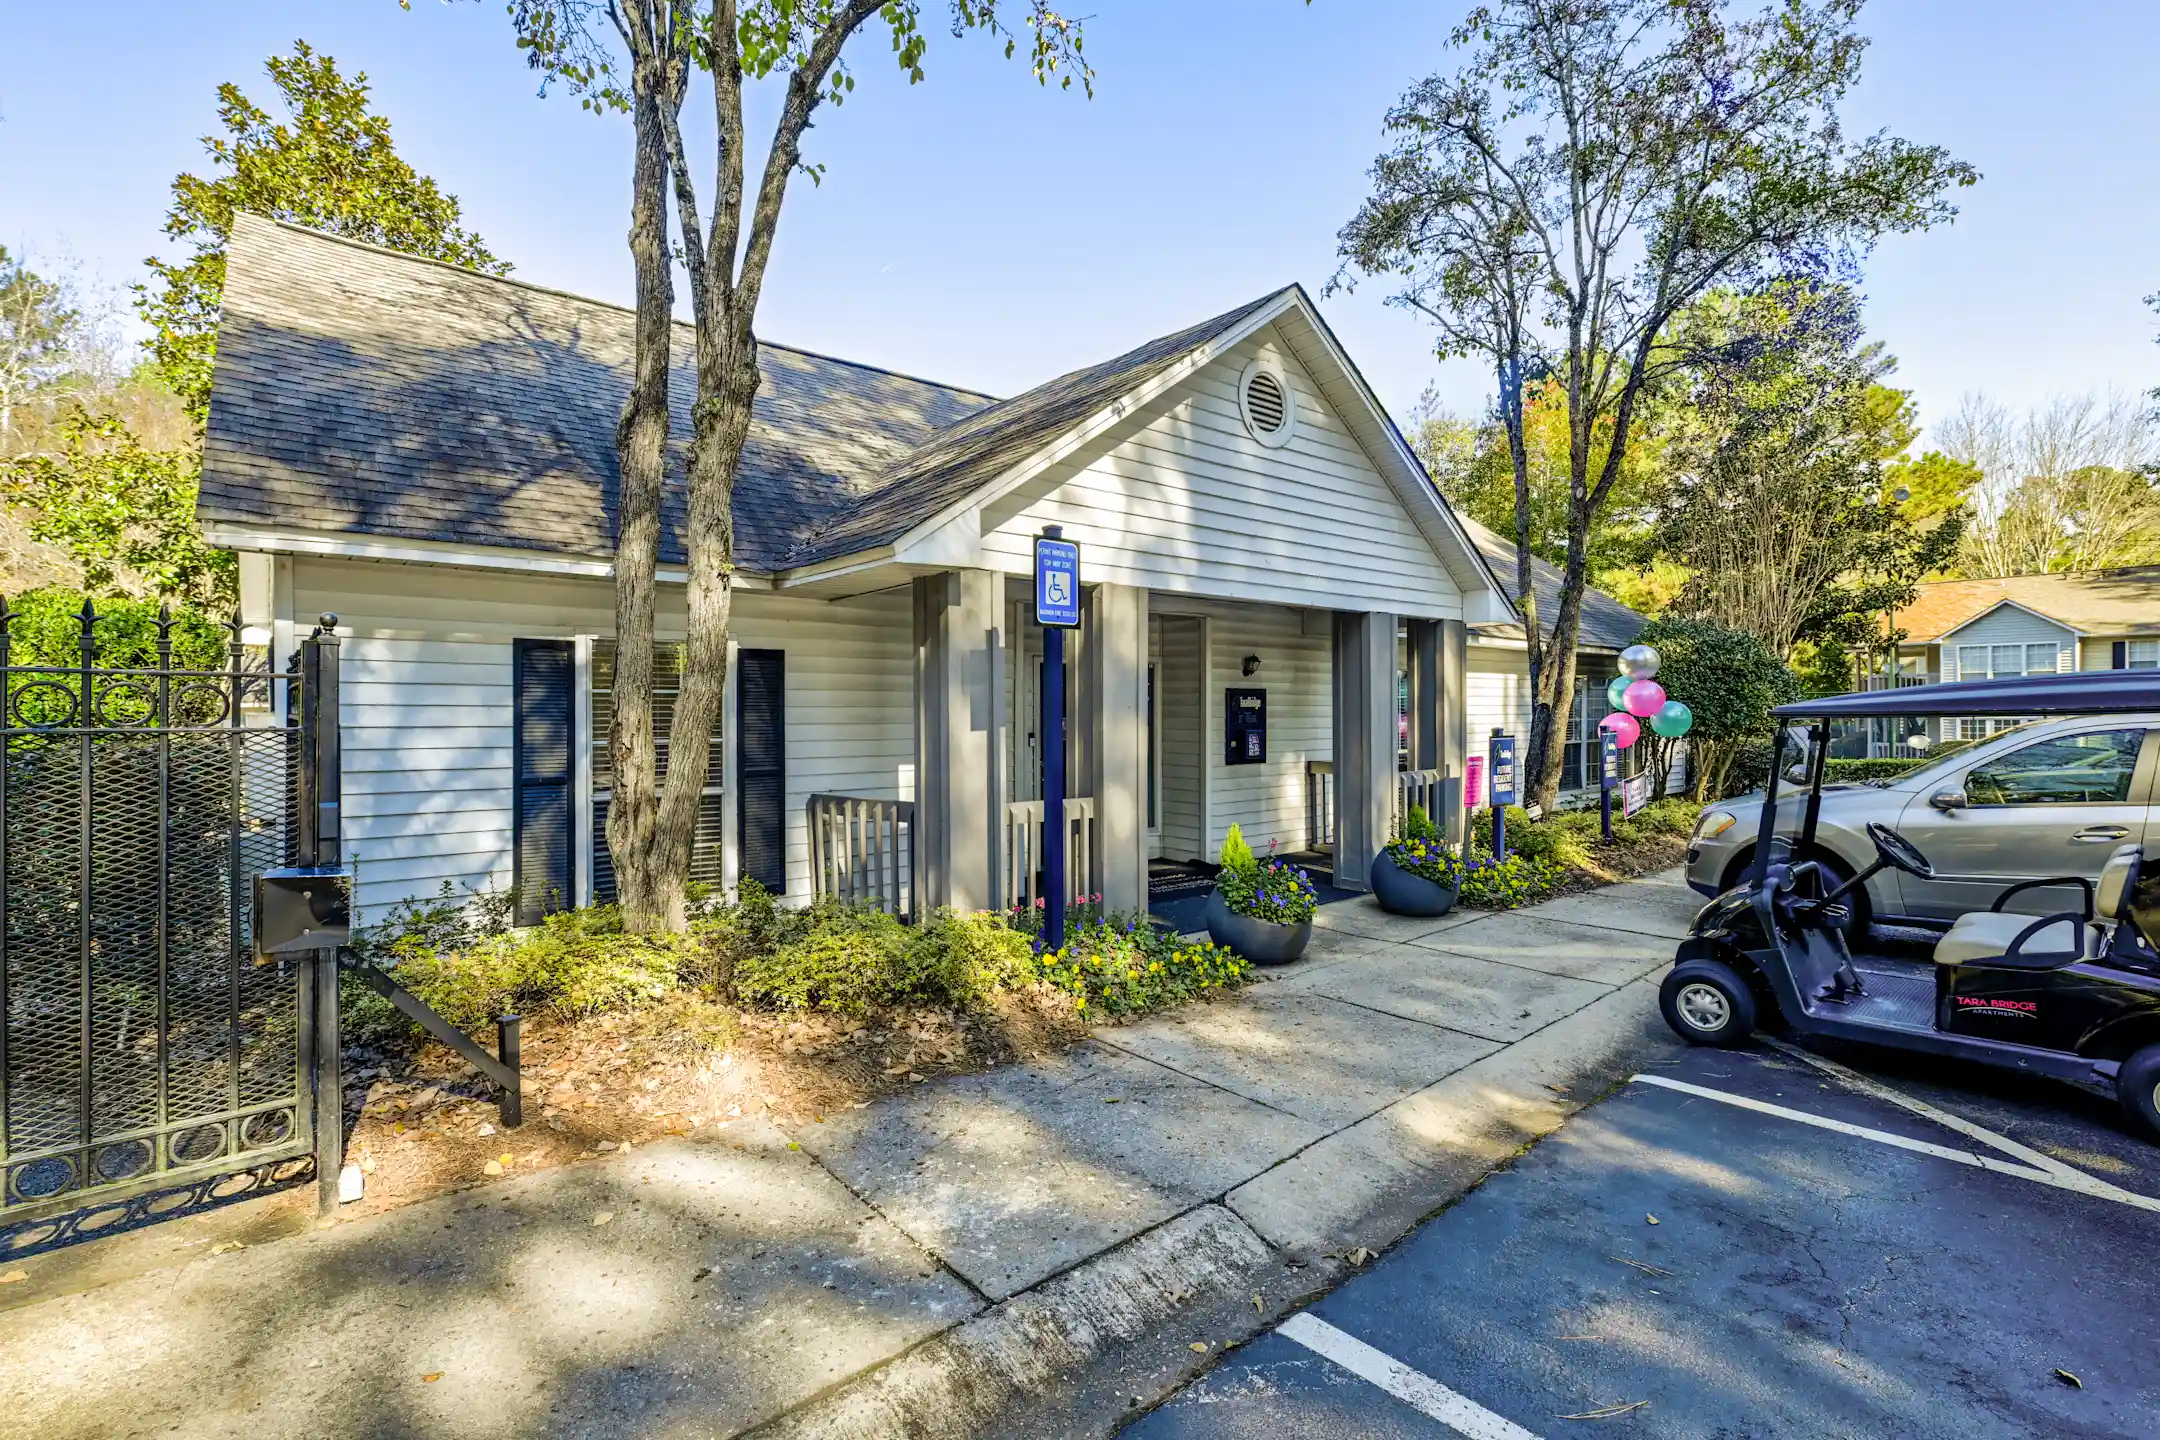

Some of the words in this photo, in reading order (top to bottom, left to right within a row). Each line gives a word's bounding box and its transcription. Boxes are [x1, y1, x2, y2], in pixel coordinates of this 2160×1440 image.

[1956, 996, 1989, 1007] TARA
[1990, 999, 2037, 1012] BRIDGE
[1972, 1009, 2025, 1018] APARTMENTS
